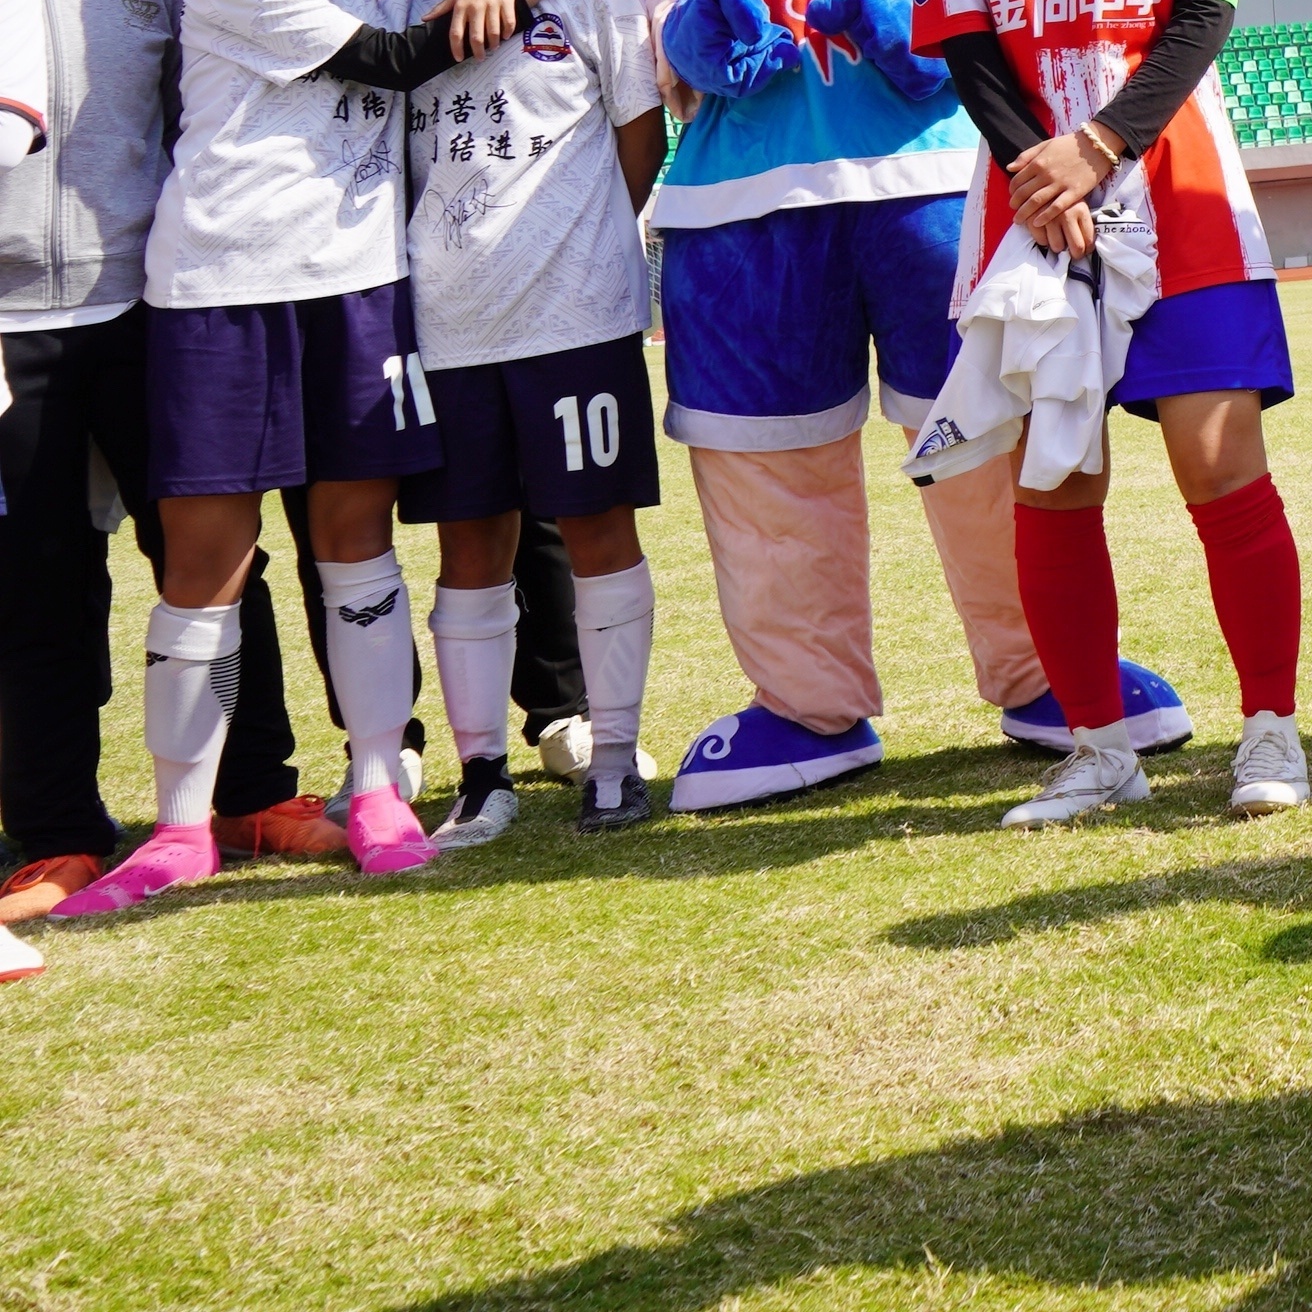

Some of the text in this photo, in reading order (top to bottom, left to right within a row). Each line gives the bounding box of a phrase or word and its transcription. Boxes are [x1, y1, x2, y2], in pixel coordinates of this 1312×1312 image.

[1106, 21, 1120, 29] he
[1121, 21, 1147, 30] zhong
[431, 129, 554, 164] 结进取
[1104, 224, 1118, 234] he
[382, 351, 437, 432] 11
[553, 392, 620, 472] 10
